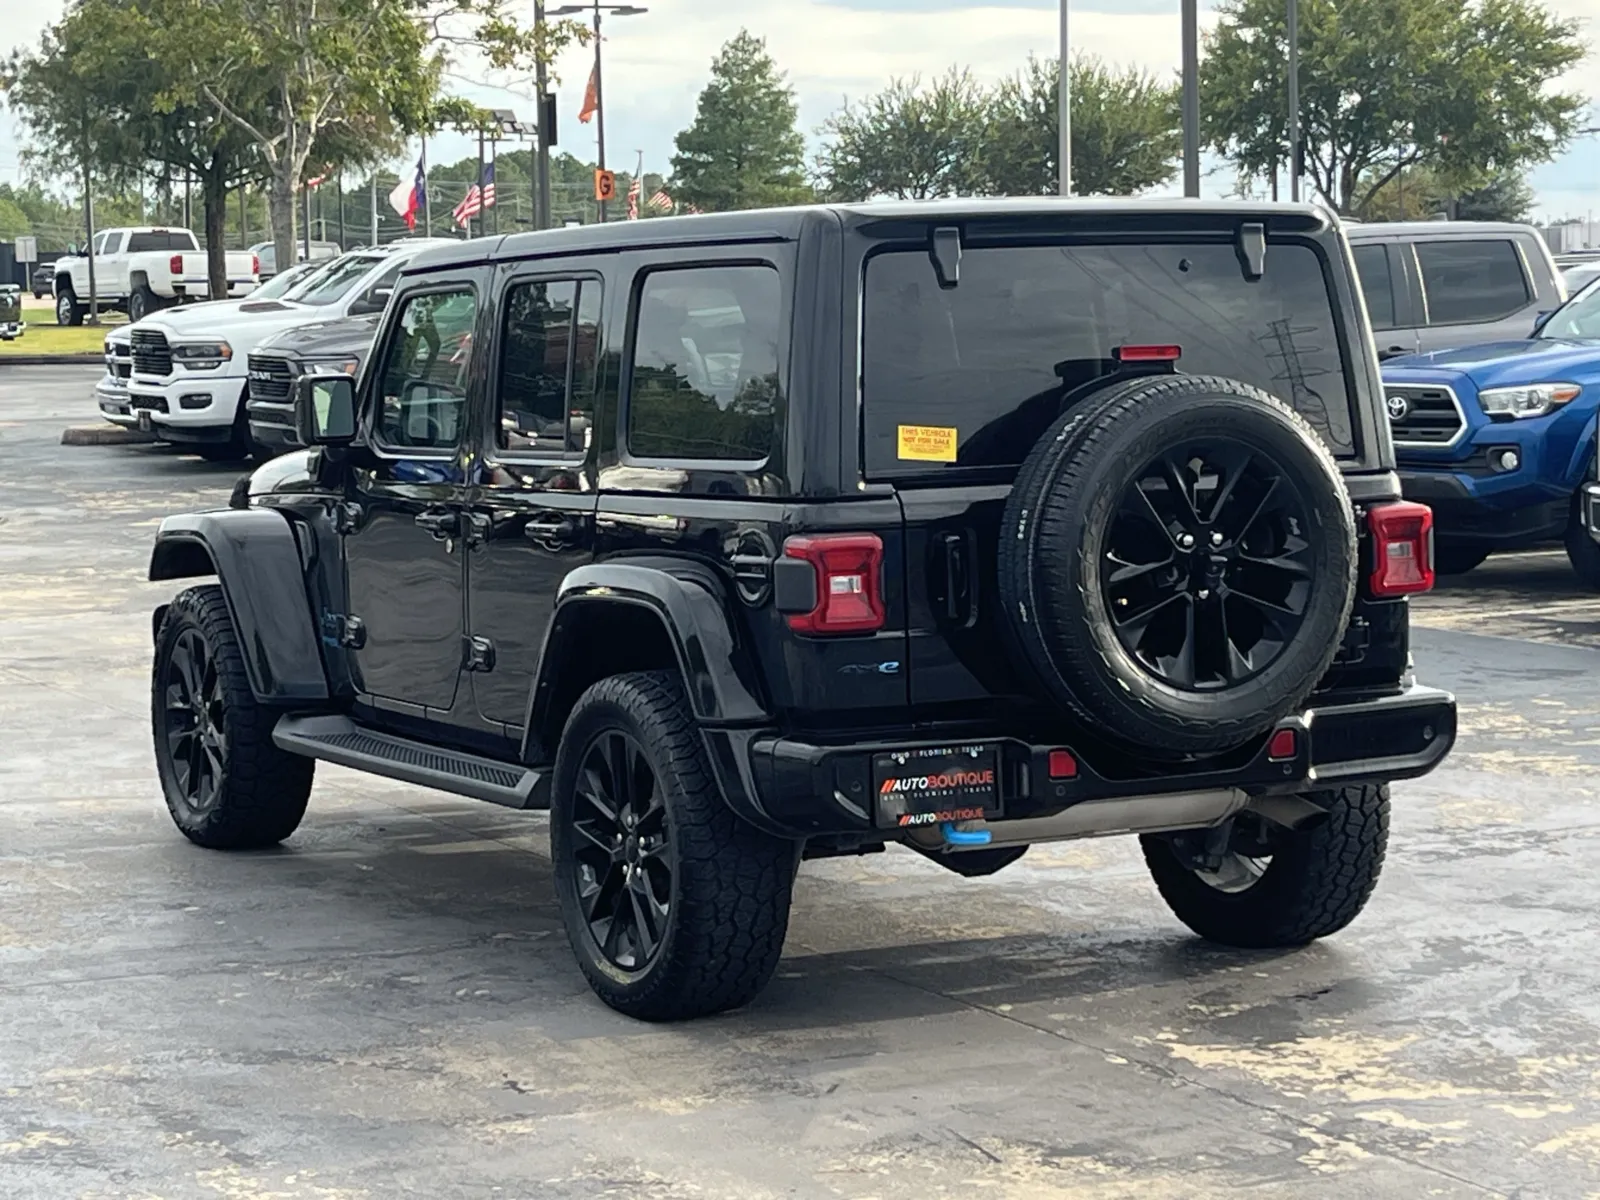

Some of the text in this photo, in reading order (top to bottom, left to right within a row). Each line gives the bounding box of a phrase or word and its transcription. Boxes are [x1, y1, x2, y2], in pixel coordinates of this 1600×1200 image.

[599, 175, 611, 196] G
[920, 428, 952, 437] VEHICLE
[919, 749, 952, 757] FLORIDA
[892, 771, 994, 792] AUTOBOUTIQUE
[908, 808, 984, 825] AUTOBOUTIQUE
